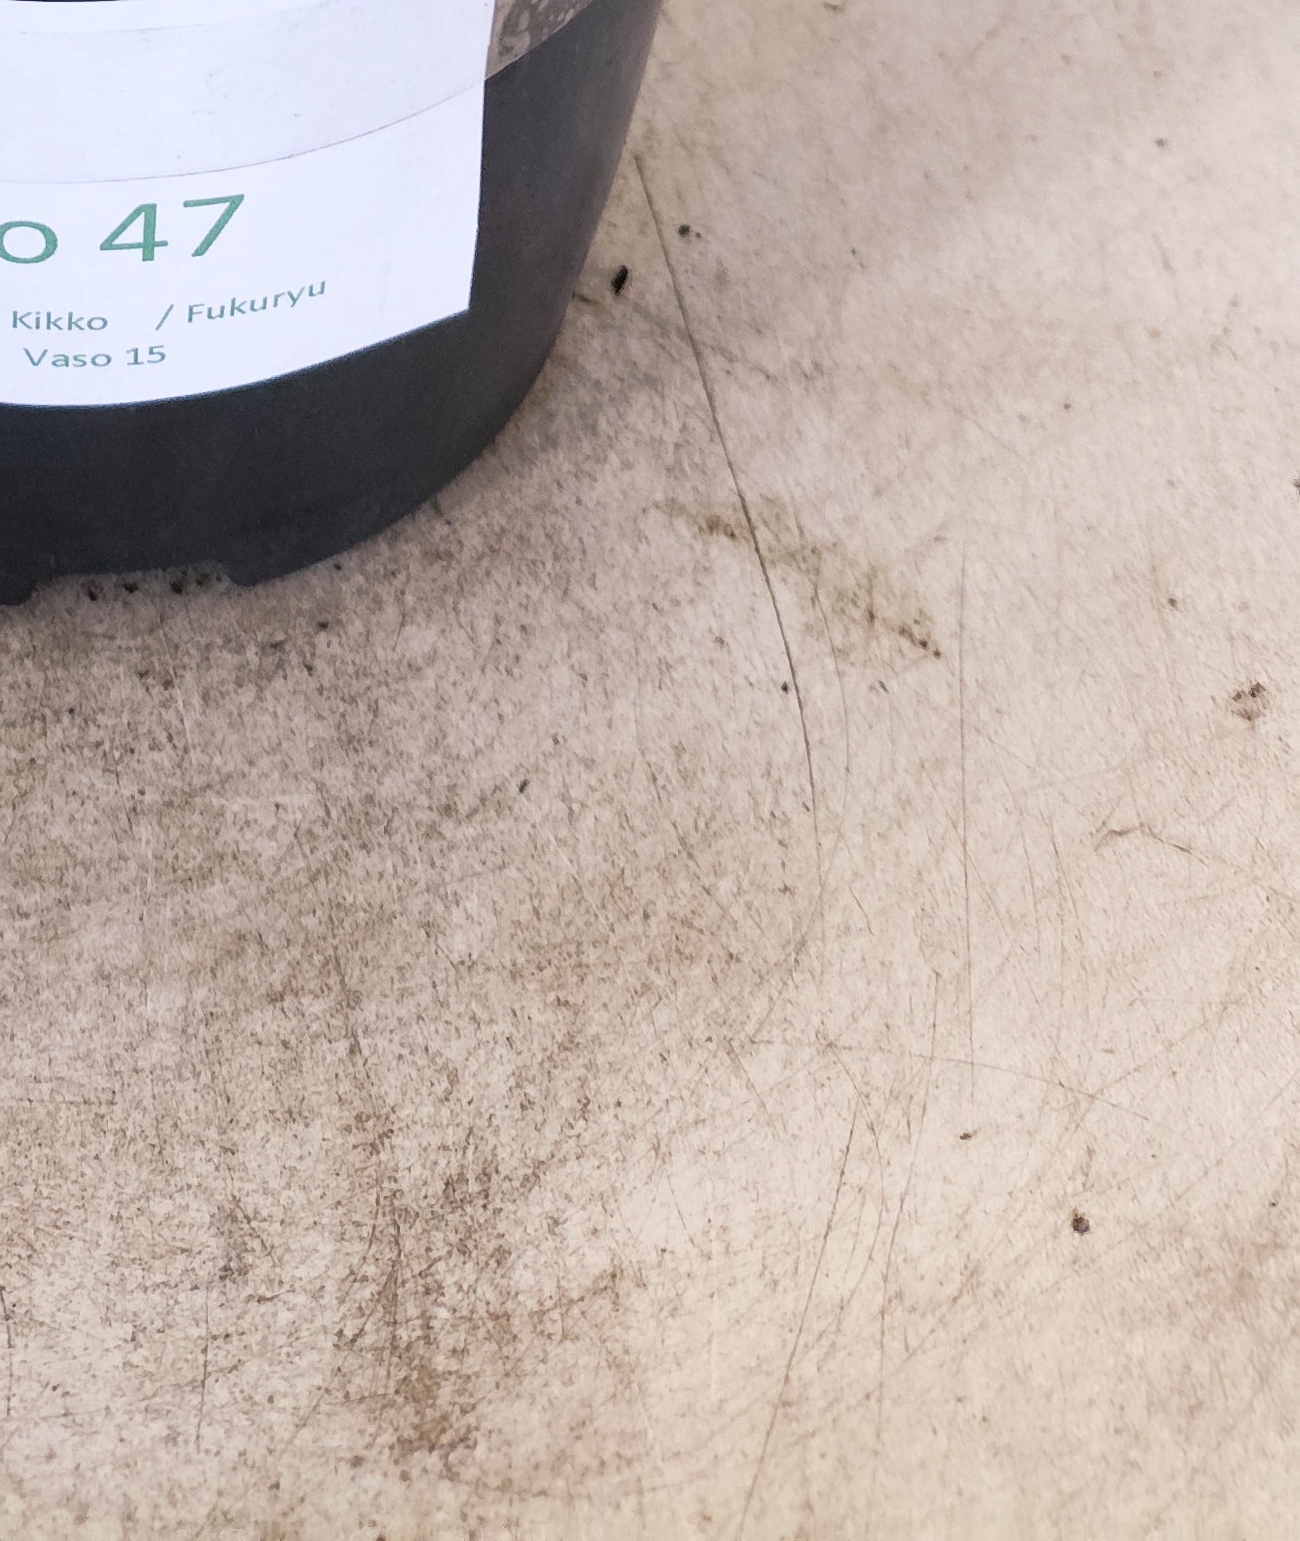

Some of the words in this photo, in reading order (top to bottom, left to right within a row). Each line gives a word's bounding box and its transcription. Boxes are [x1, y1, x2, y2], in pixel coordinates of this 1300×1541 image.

[99, 193, 246, 263] 47
[11, 309, 109, 333] Kikko
[187, 279, 329, 325] Fukuryu
[24, 347, 113, 369] Vaso
[127, 345, 167, 367] 15
